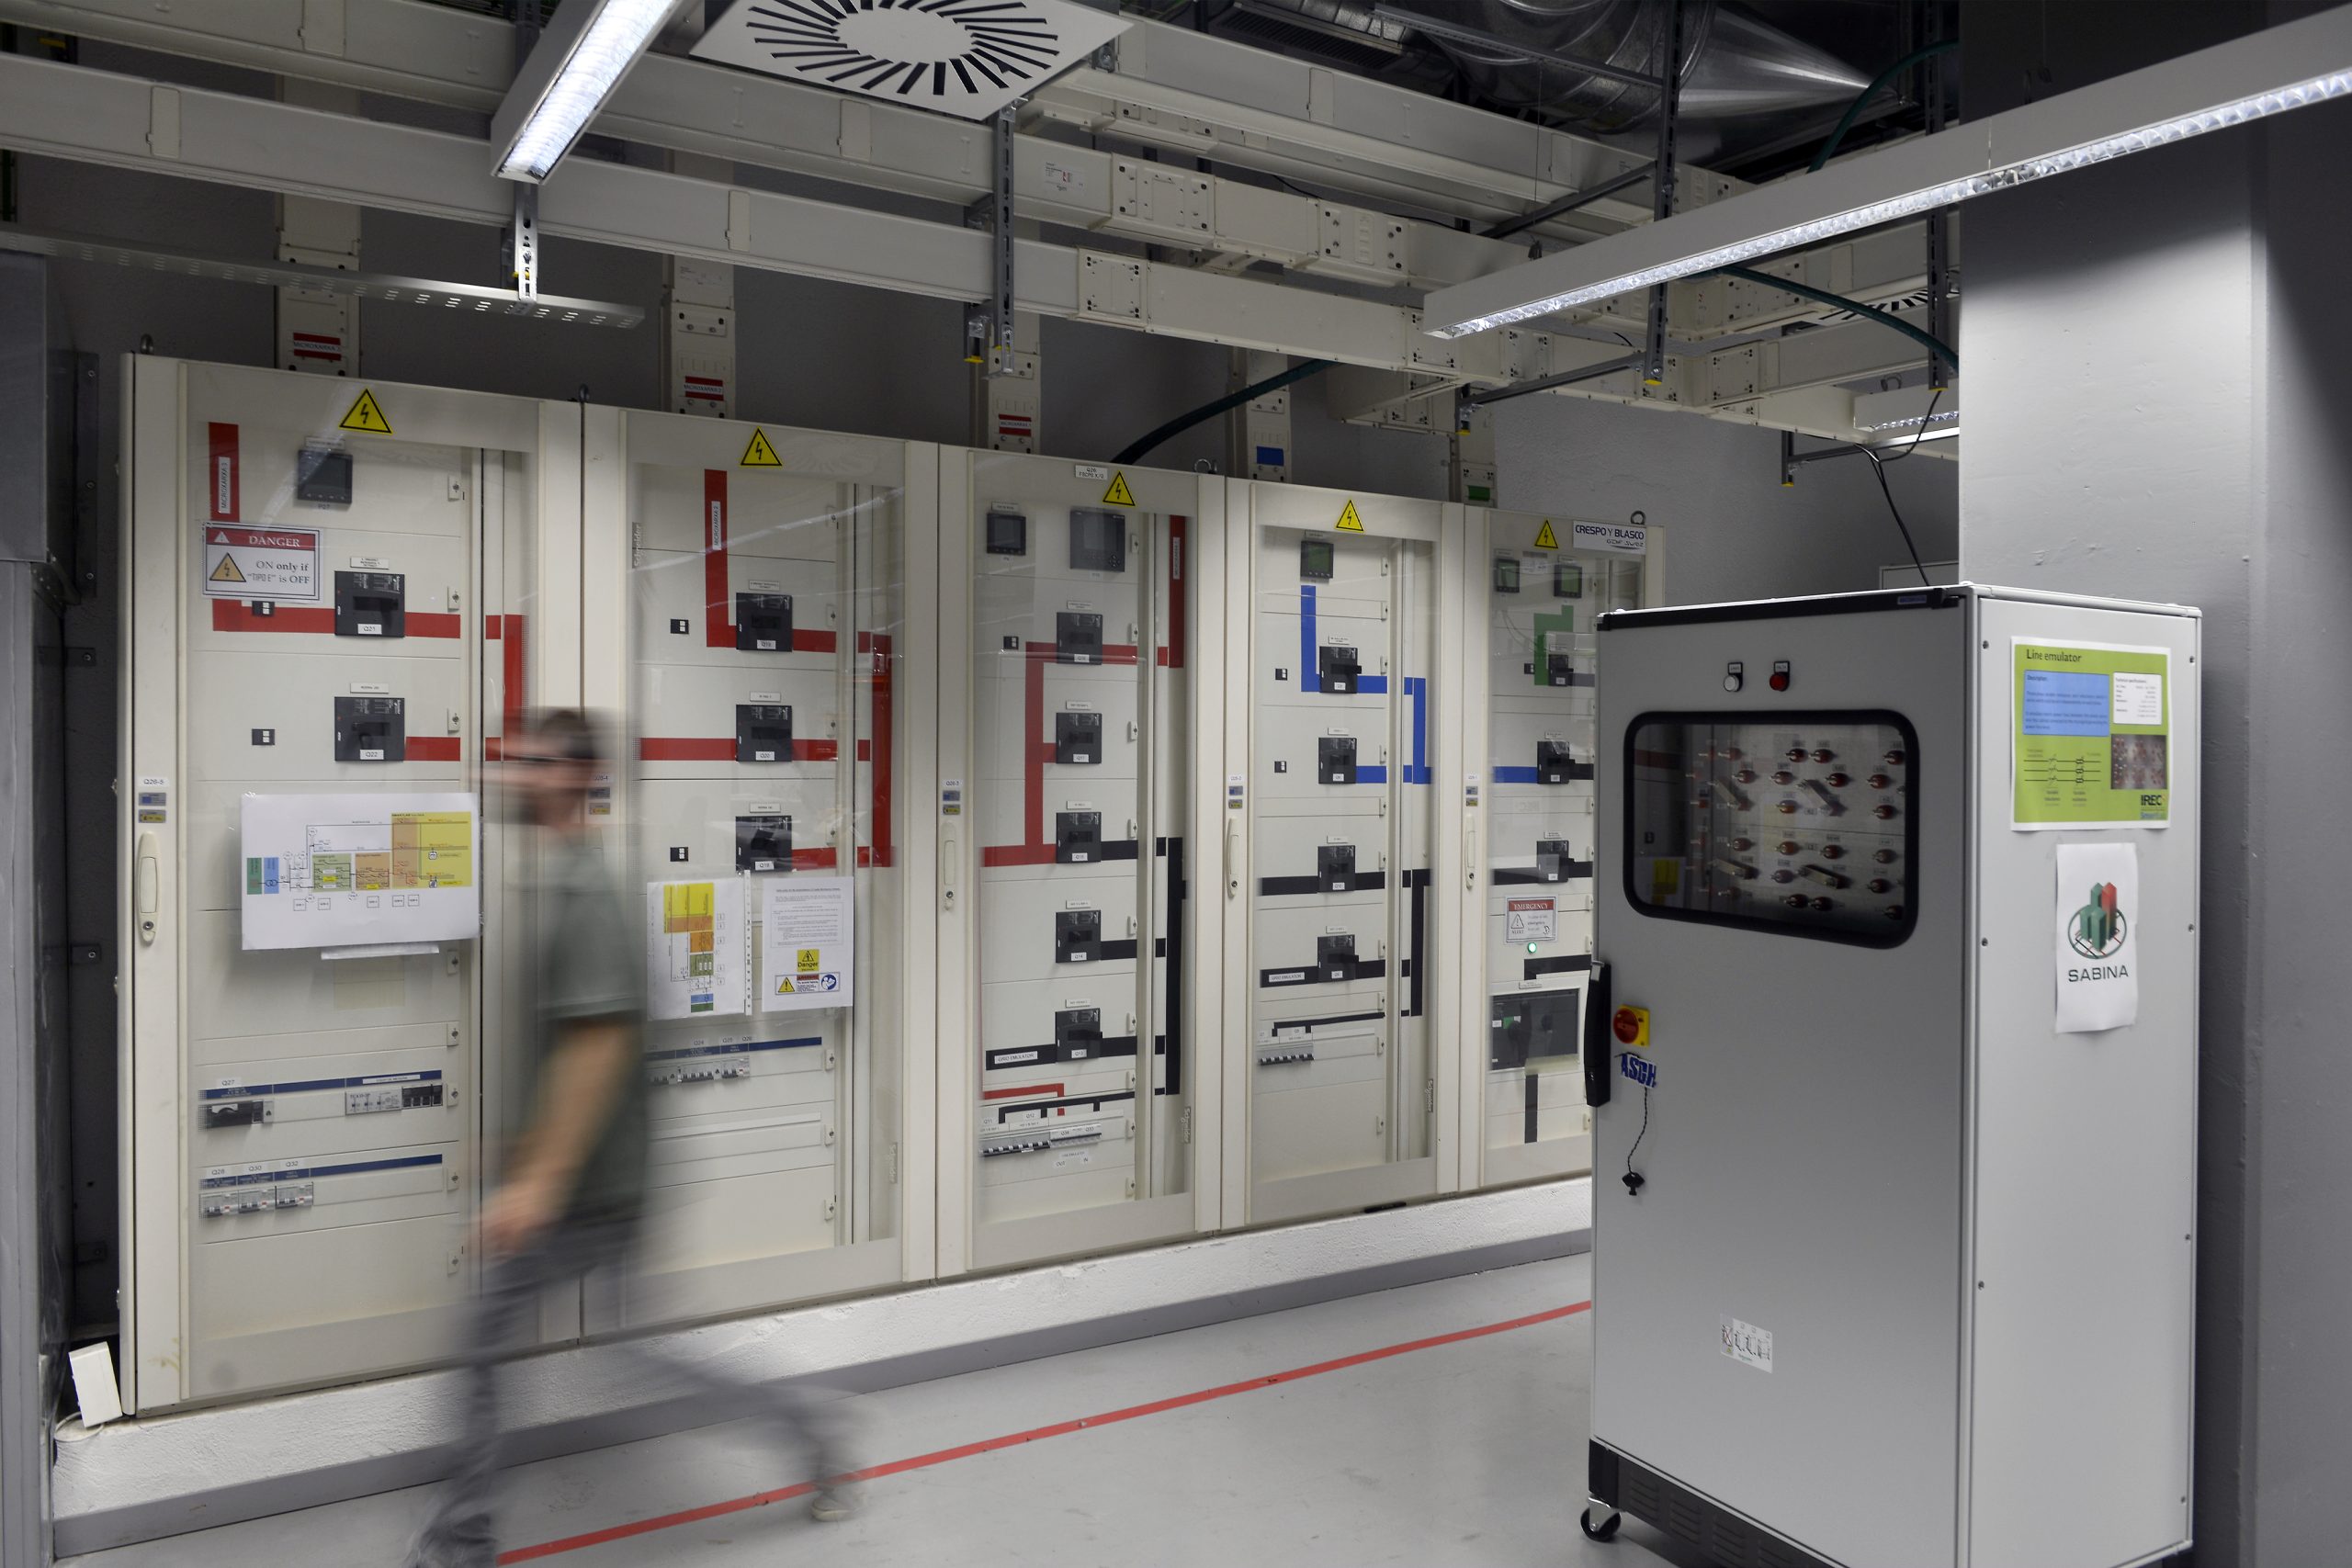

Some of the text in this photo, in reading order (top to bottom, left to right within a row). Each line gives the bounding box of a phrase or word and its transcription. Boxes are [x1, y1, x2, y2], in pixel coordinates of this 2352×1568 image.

[1575, 525, 1645, 540] CRESPO Y BLASCO
[249, 535, 301, 547] DANGER
[256, 560, 310, 573] ON only if
[279, 575, 288, 583] is
[289, 575, 311, 584] OFF
[2026, 649, 2082, 663] Line emulator
[1514, 902, 1549, 910] EMERGENCY
[2067, 964, 2130, 983] SABINA
